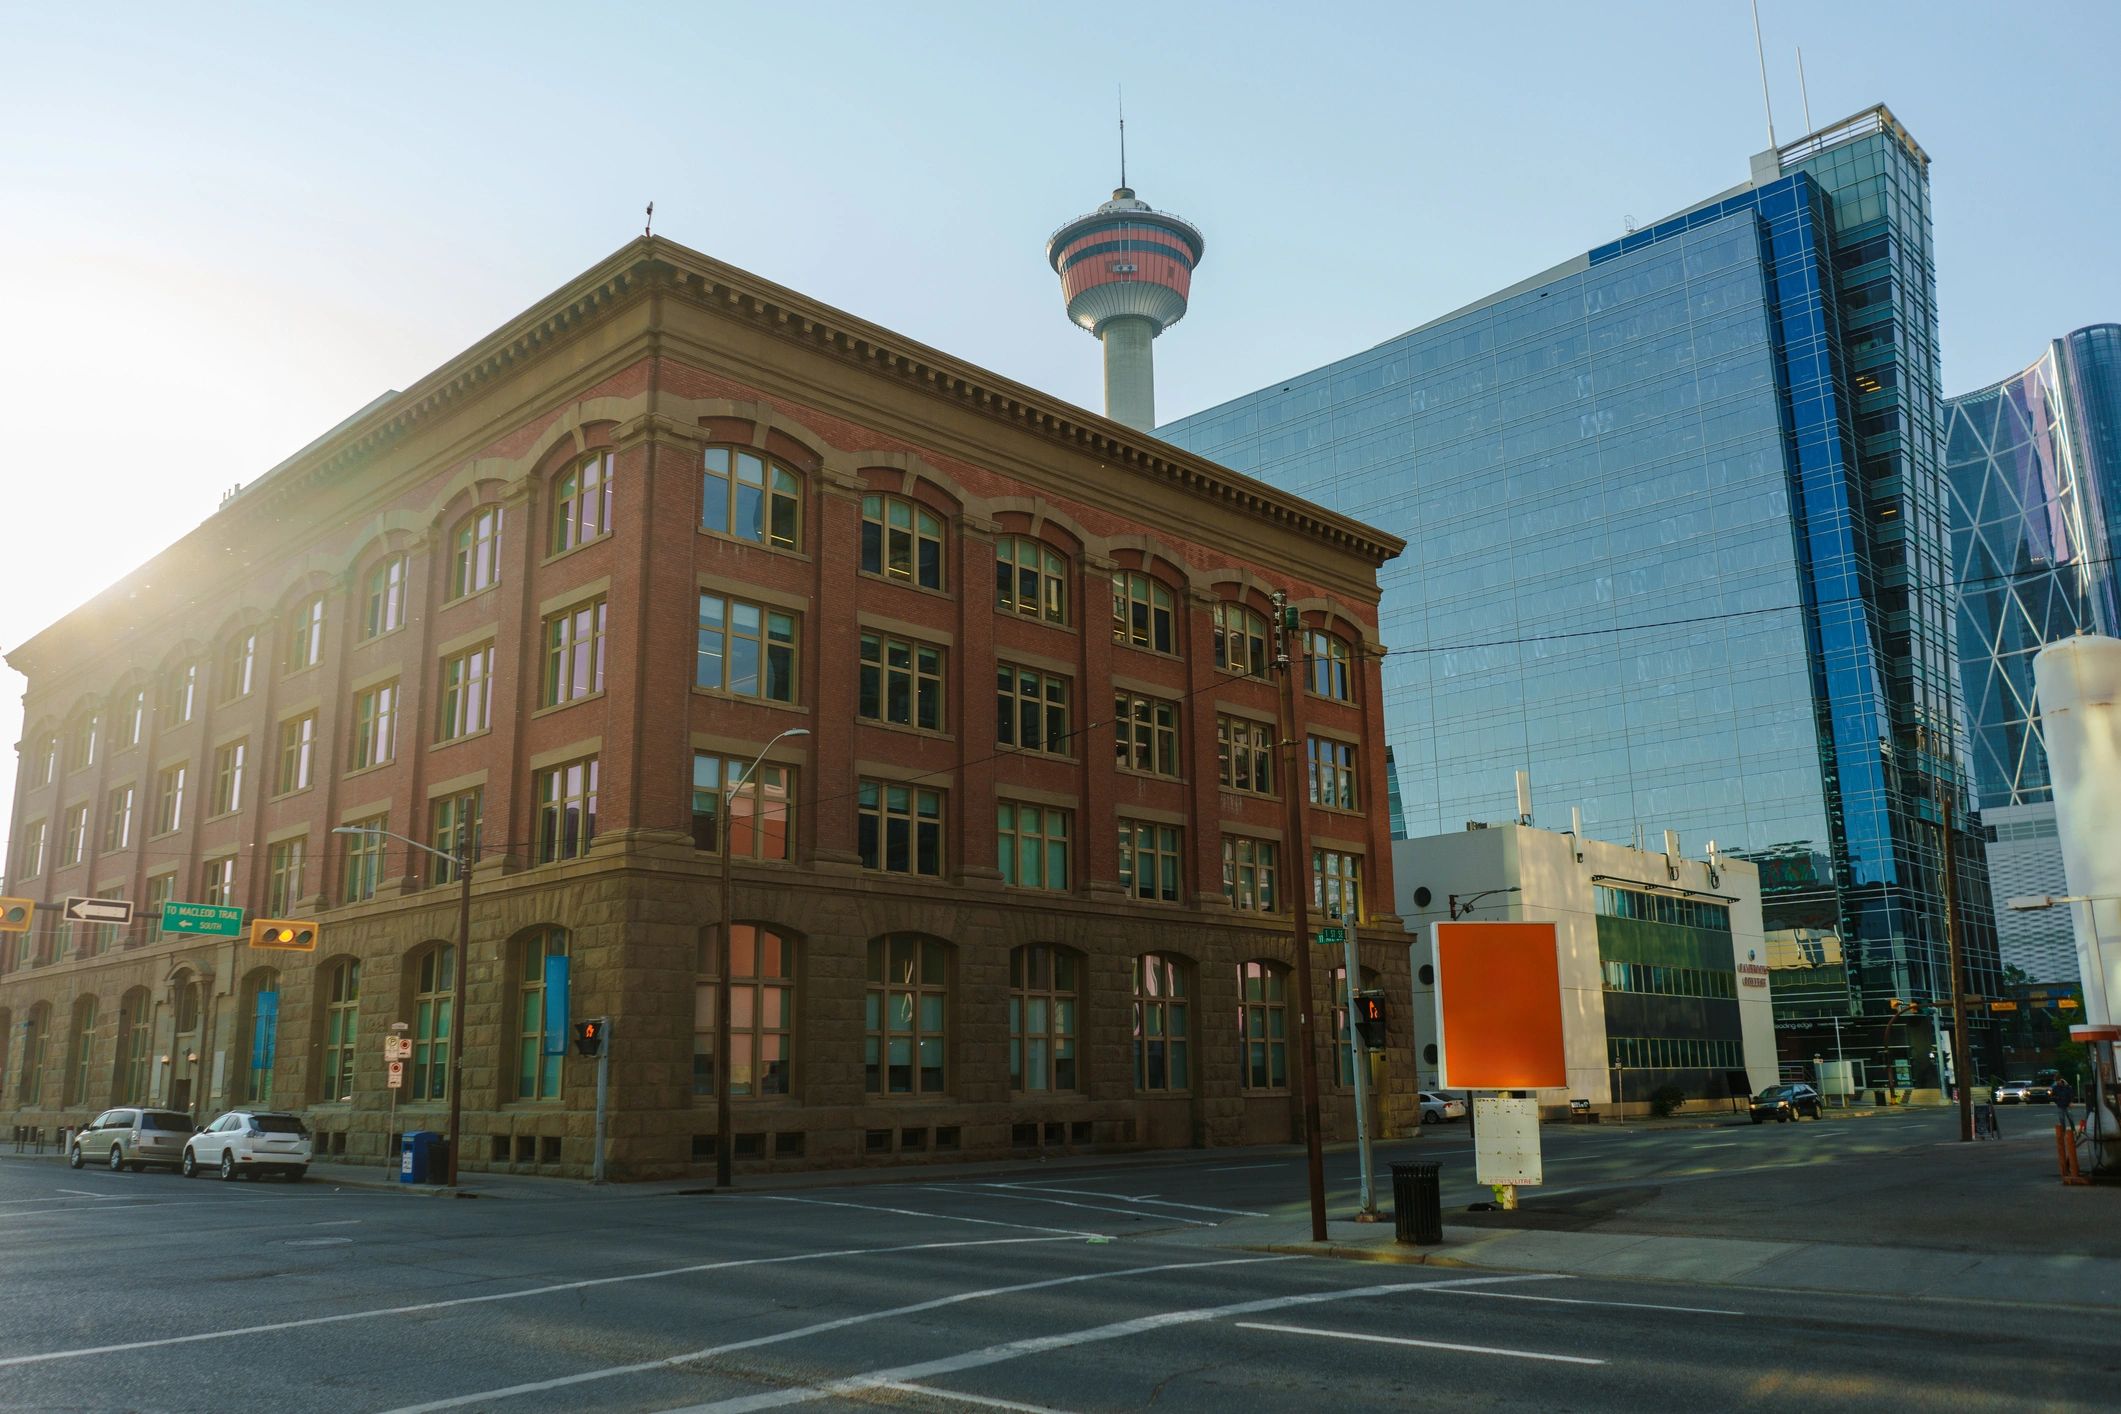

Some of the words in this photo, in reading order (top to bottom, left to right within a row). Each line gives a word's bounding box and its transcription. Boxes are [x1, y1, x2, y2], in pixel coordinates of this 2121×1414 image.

[167, 905, 177, 915] TO
[179, 906, 216, 918] MACLEOD
[218, 909, 239, 920] TRAIL
[199, 921, 222, 930] SOUTH
